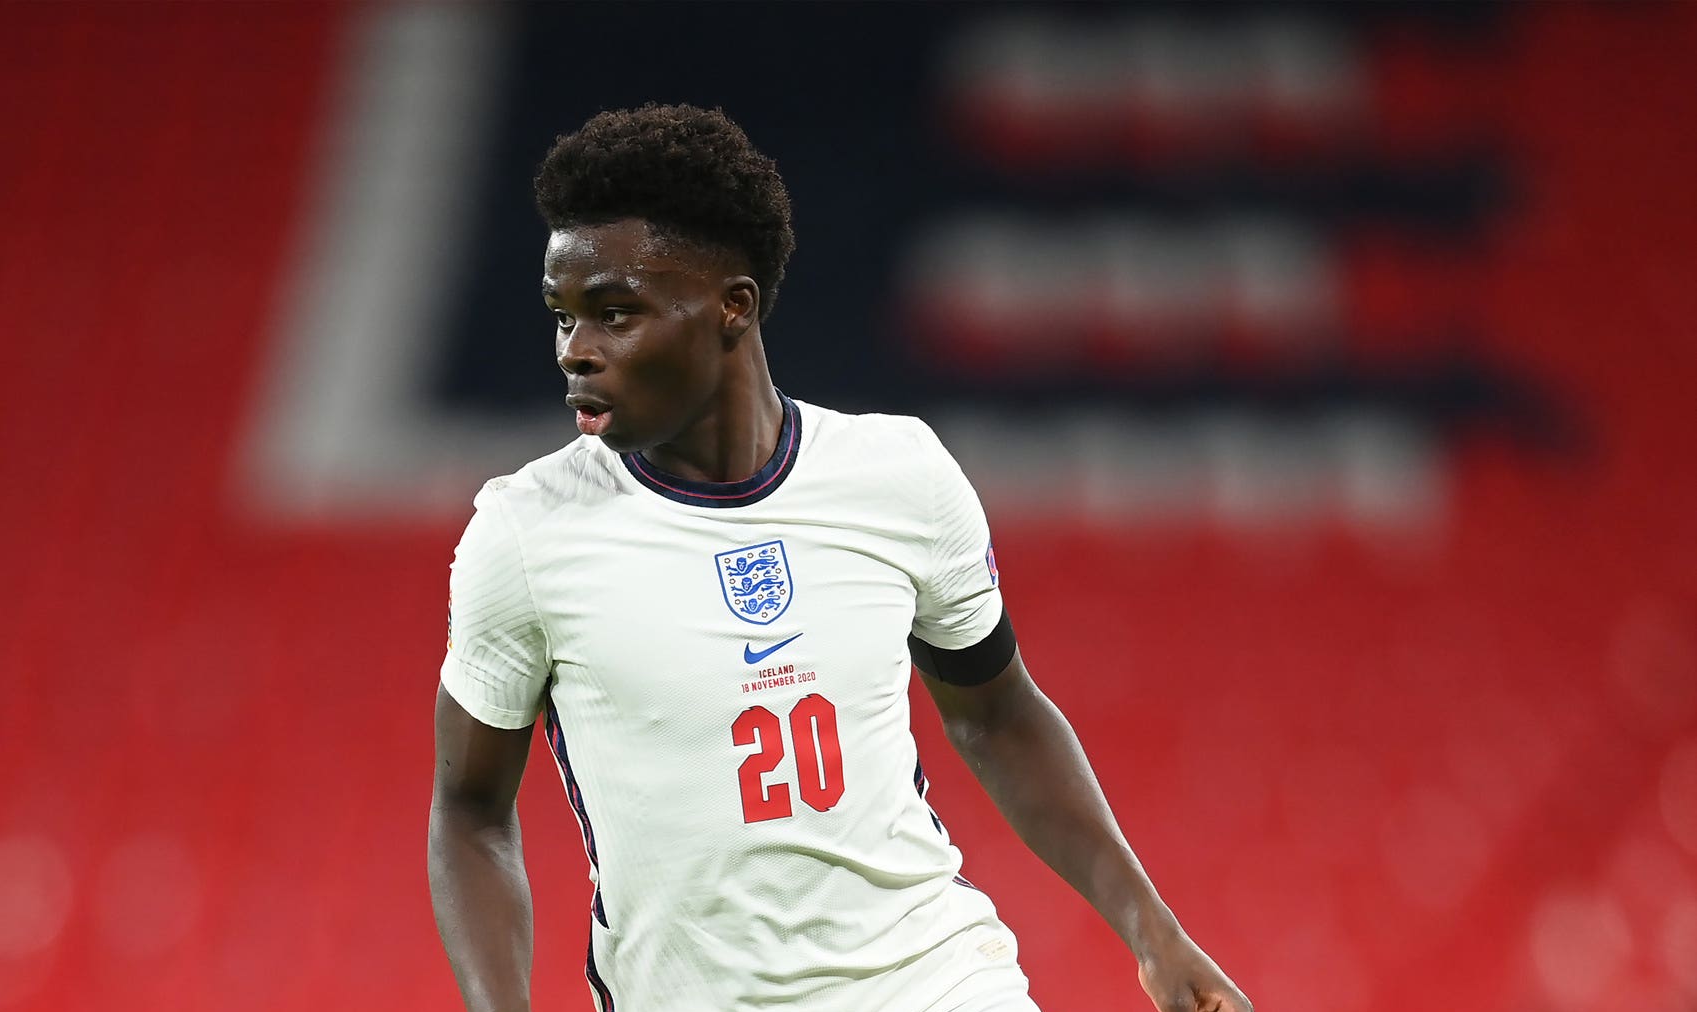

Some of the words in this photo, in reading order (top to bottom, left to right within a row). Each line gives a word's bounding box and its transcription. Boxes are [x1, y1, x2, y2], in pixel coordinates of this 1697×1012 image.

[741, 683, 750, 693] 18
[751, 675, 795, 691] NOVEMBER
[797, 671, 816, 683] 2020
[759, 664, 794, 679] ICELAND
[731, 693, 845, 824] 20
